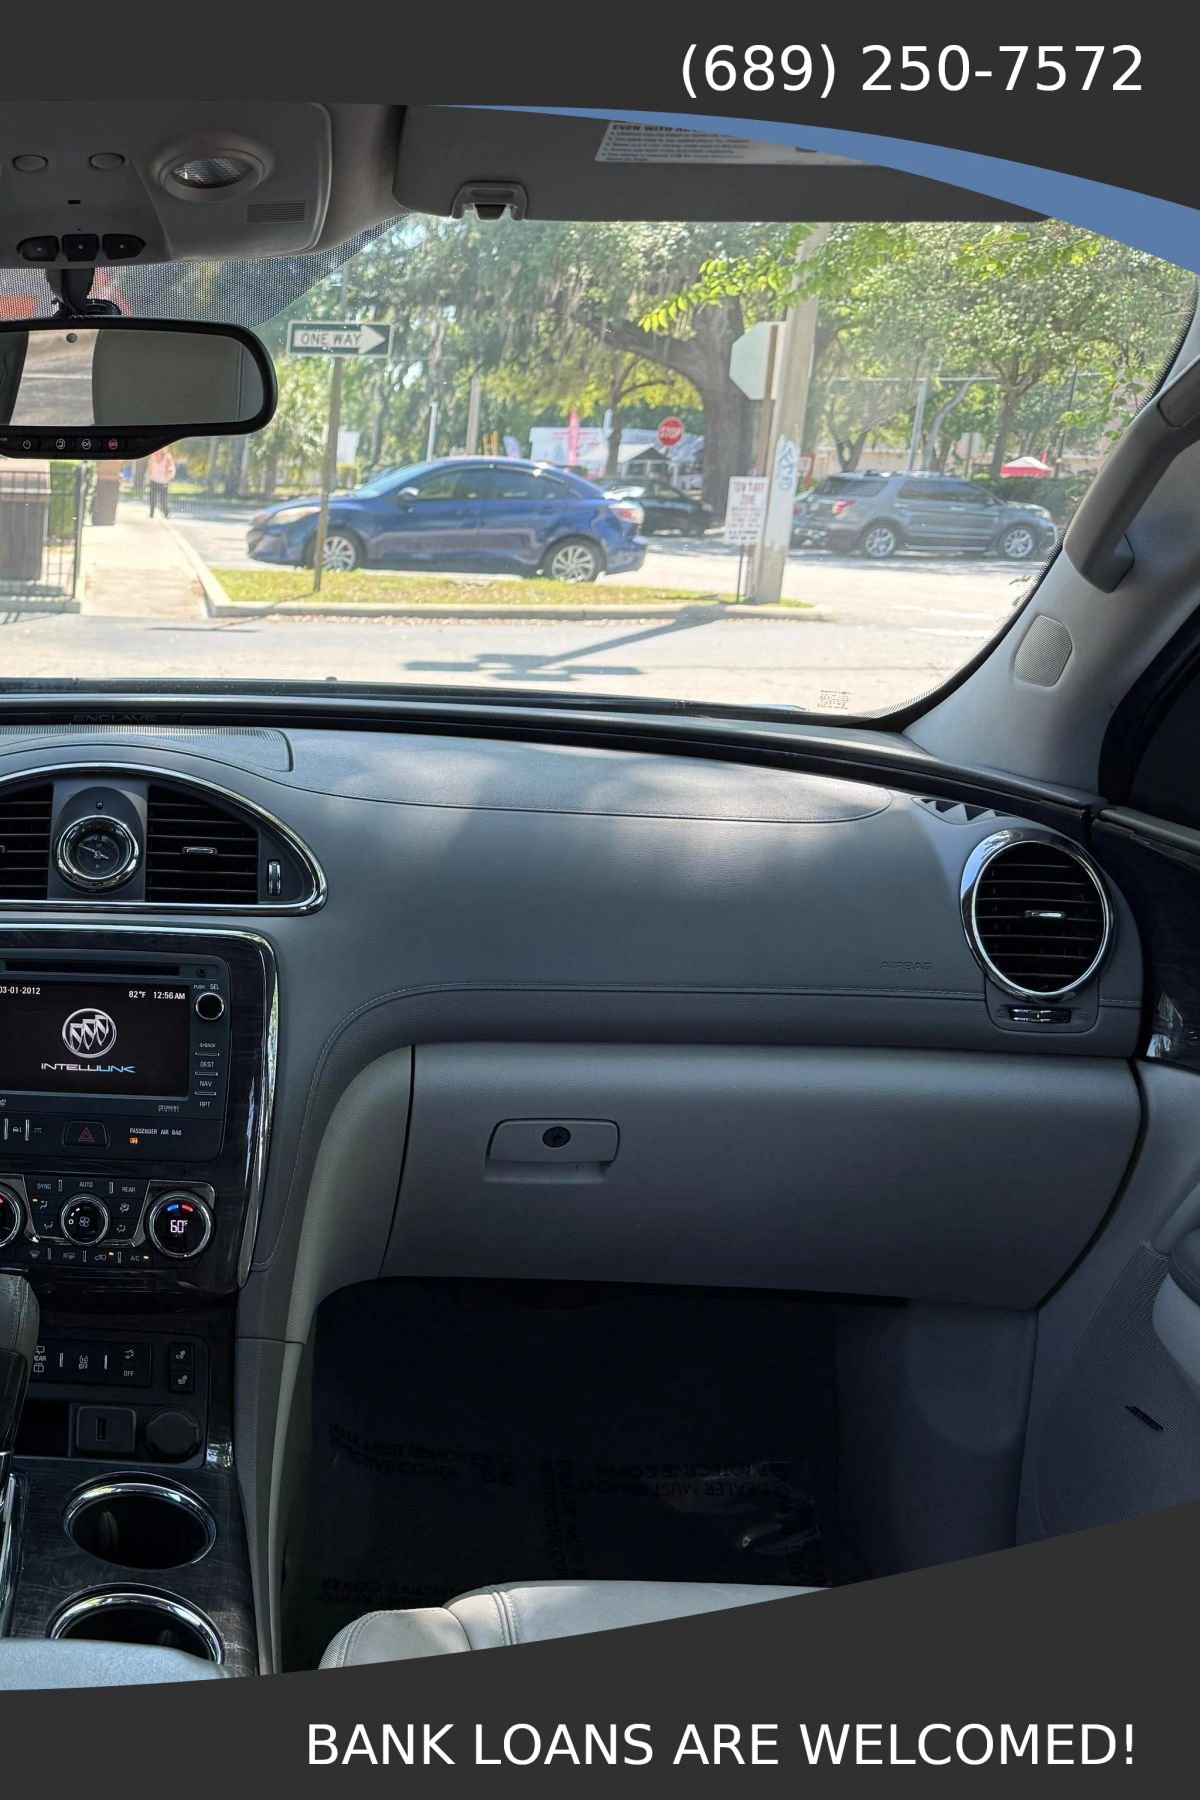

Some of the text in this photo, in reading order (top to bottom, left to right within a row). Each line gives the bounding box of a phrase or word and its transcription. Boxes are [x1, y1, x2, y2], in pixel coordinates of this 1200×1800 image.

[301, 333, 362, 346] ONE WAY
[660, 426, 682, 439] STOP
[74, 713, 157, 723] ENCLAVE
[879, 960, 935, 970] AIRBAG
[153, 991, 174, 1000] 12:56
[174, 992, 186, 1000] AM
[199, 1061, 214, 1069] DEST
[199, 1080, 212, 1088] NAV
[129, 1127, 158, 1135] PASSENGER
[36, 1182, 52, 1190] SYNC
[79, 1181, 94, 1189] AUTO
[655, 1482, 699, 1498] MUST
[703, 1480, 771, 1496] DEALER
